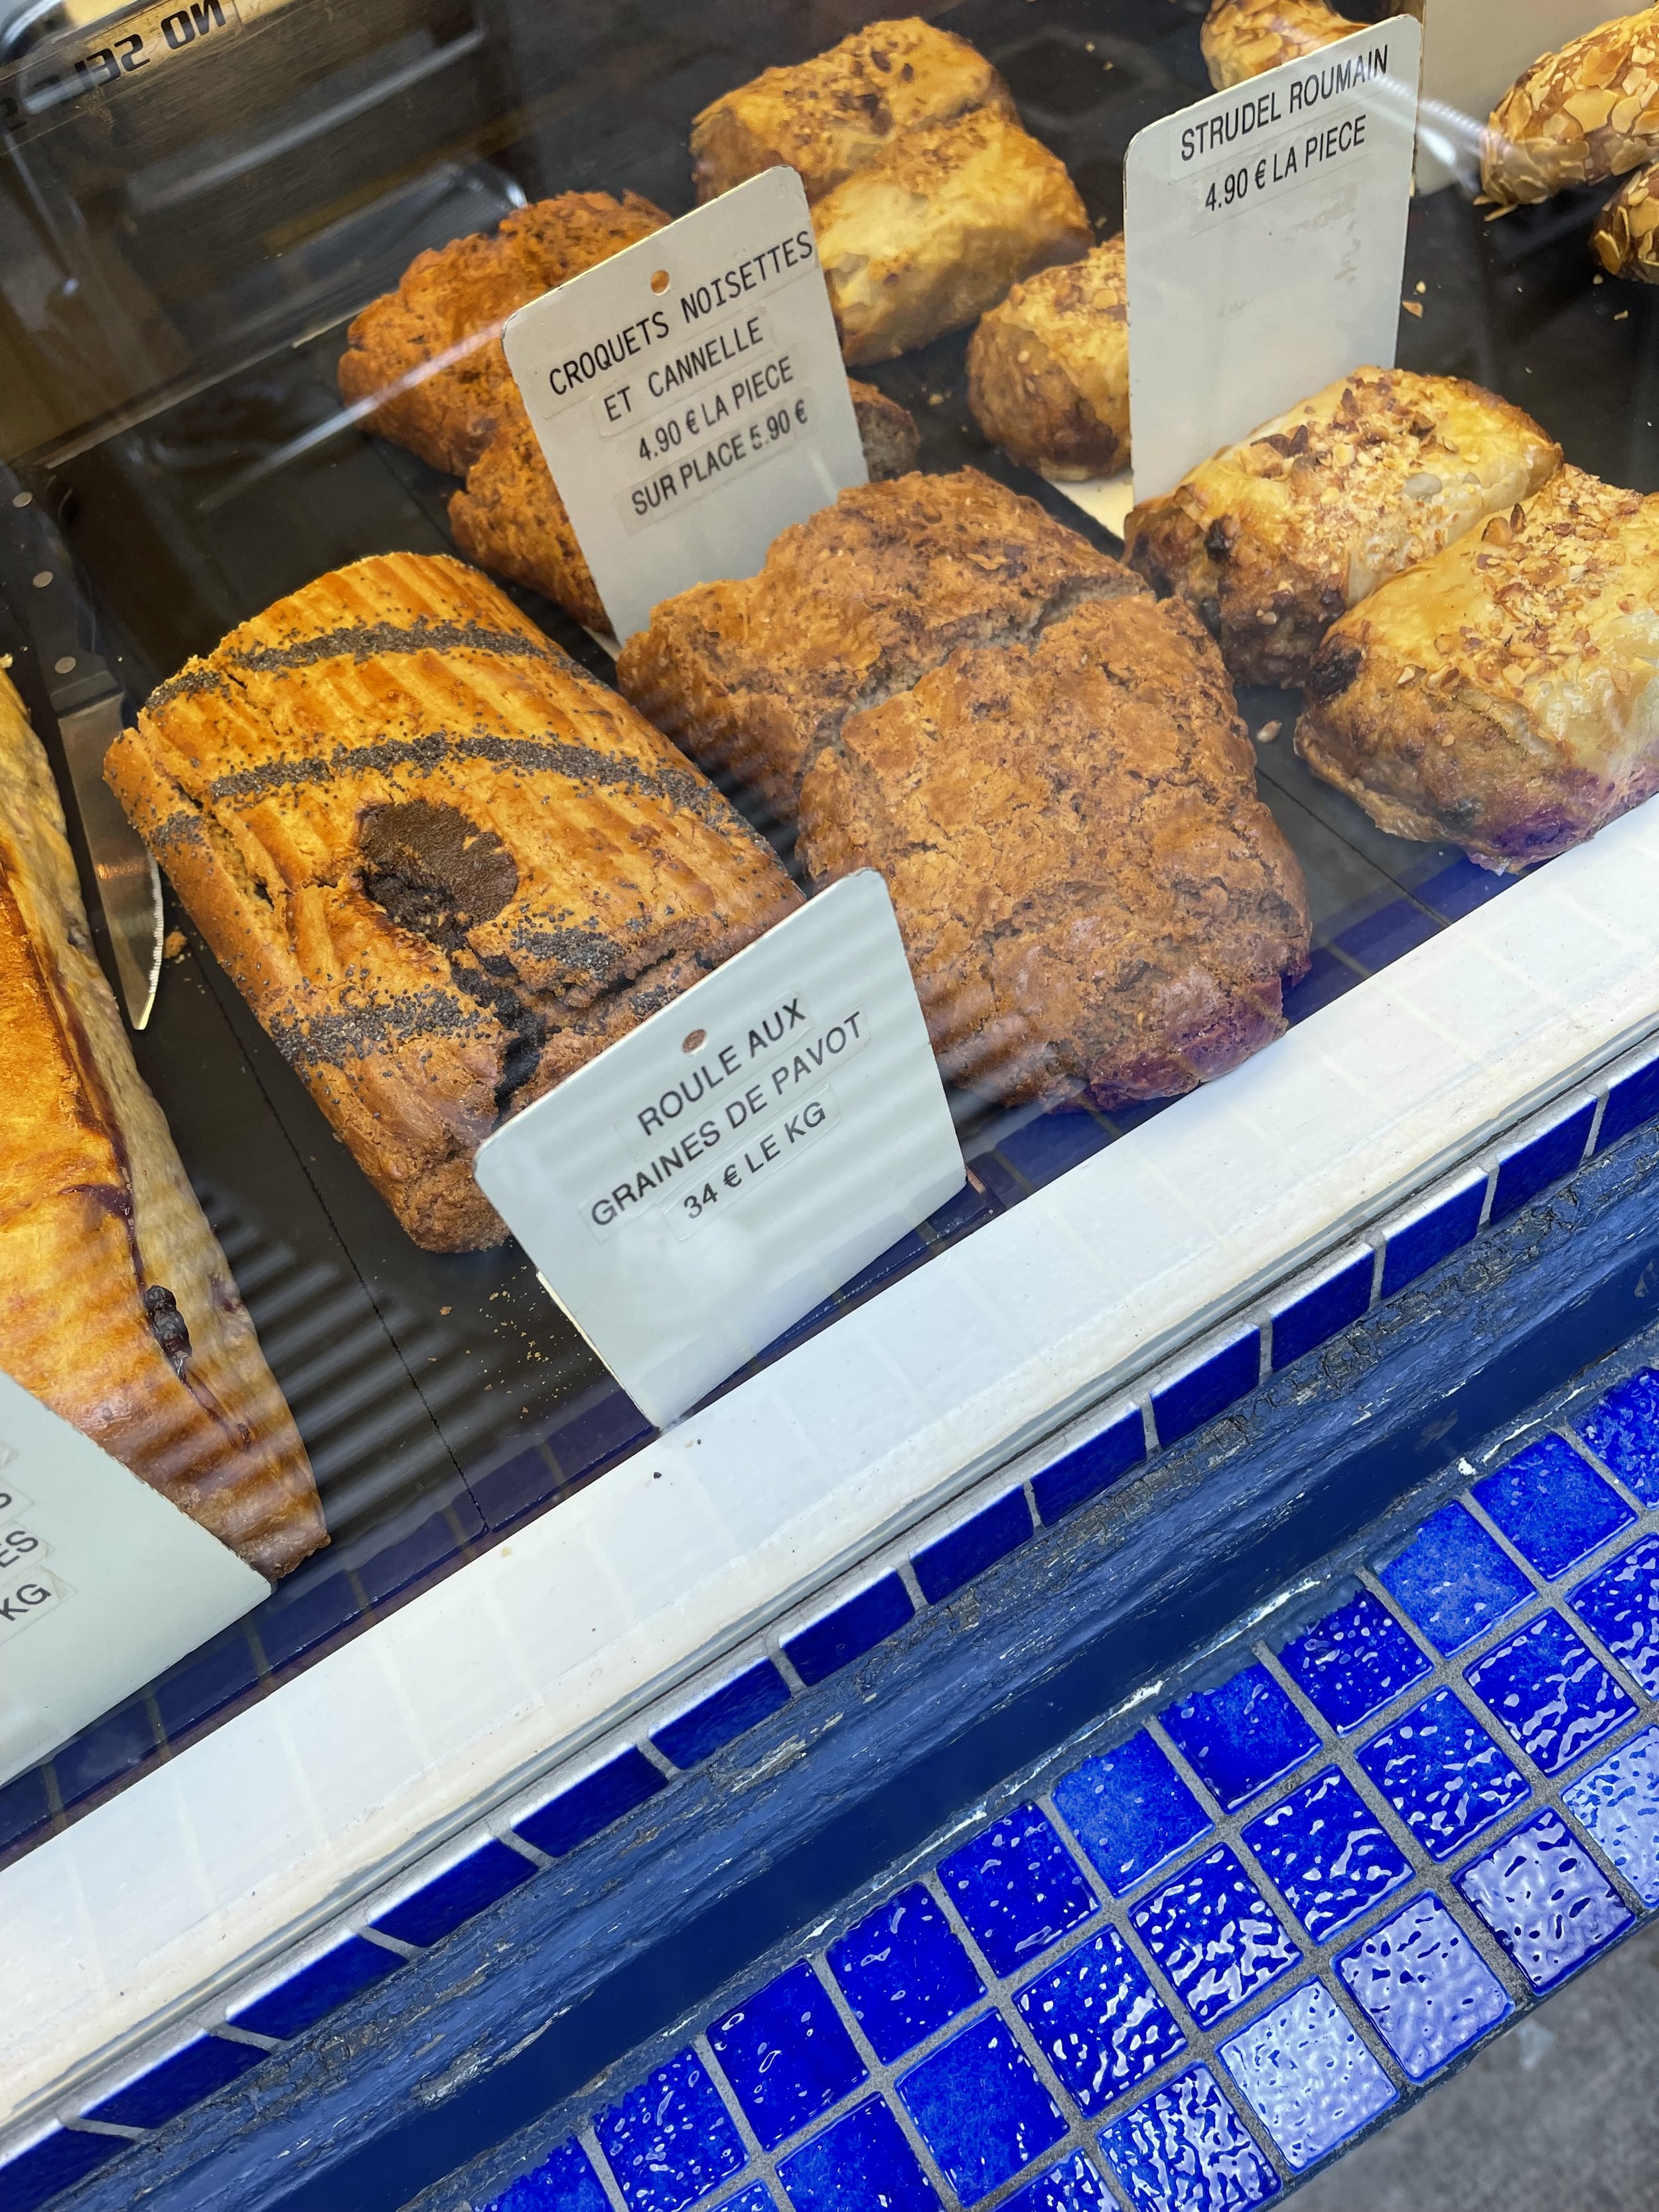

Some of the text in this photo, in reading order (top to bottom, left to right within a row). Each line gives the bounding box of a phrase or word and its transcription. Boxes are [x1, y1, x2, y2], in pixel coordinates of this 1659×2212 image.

[1181, 44, 1388, 161] STRUDEL ROUMAIN
[1205, 115, 1366, 212] 4.90 € LA PIECE
[549, 231, 813, 396] CROQUETS NOISETTES
[603, 317, 763, 422] ET CANNELLE
[631, 473, 678, 516] SUR
[680, 434, 747, 490] PLACE
[795, 399, 808, 424] €
[638, 356, 793, 461] 4.90 € LA PIECE
[591, 1011, 861, 1226] GRAINES DE PAVOT
[637, 998, 807, 1136] ROULE AUX
[683, 1101, 827, 1219] 34 € LE KG
[0, 1584, 52, 1621] KG
